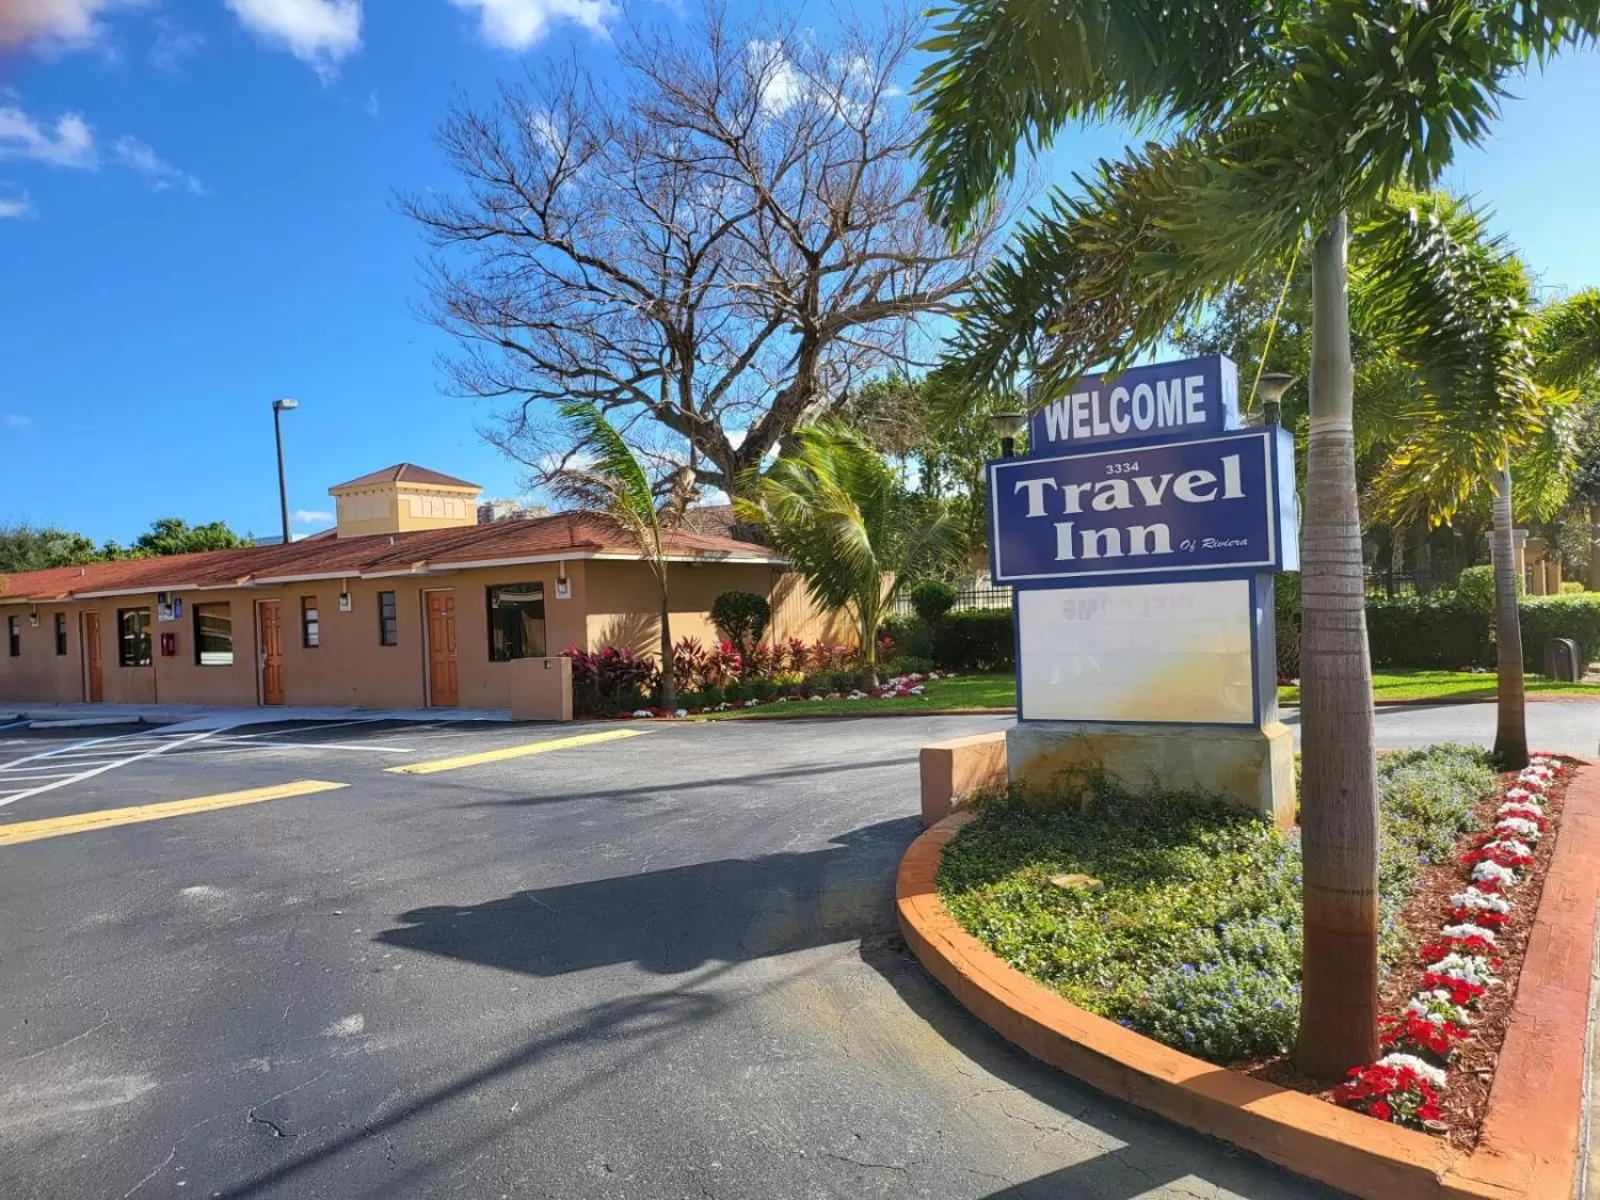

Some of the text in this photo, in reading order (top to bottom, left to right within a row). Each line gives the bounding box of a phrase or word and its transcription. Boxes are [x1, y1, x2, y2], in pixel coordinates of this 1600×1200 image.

[1044, 376, 1205, 442] WELCOME
[1014, 454, 1245, 517] Travel
[1106, 461, 1139, 474] 3334
[1053, 521, 1248, 561] Inn Of Riviera
